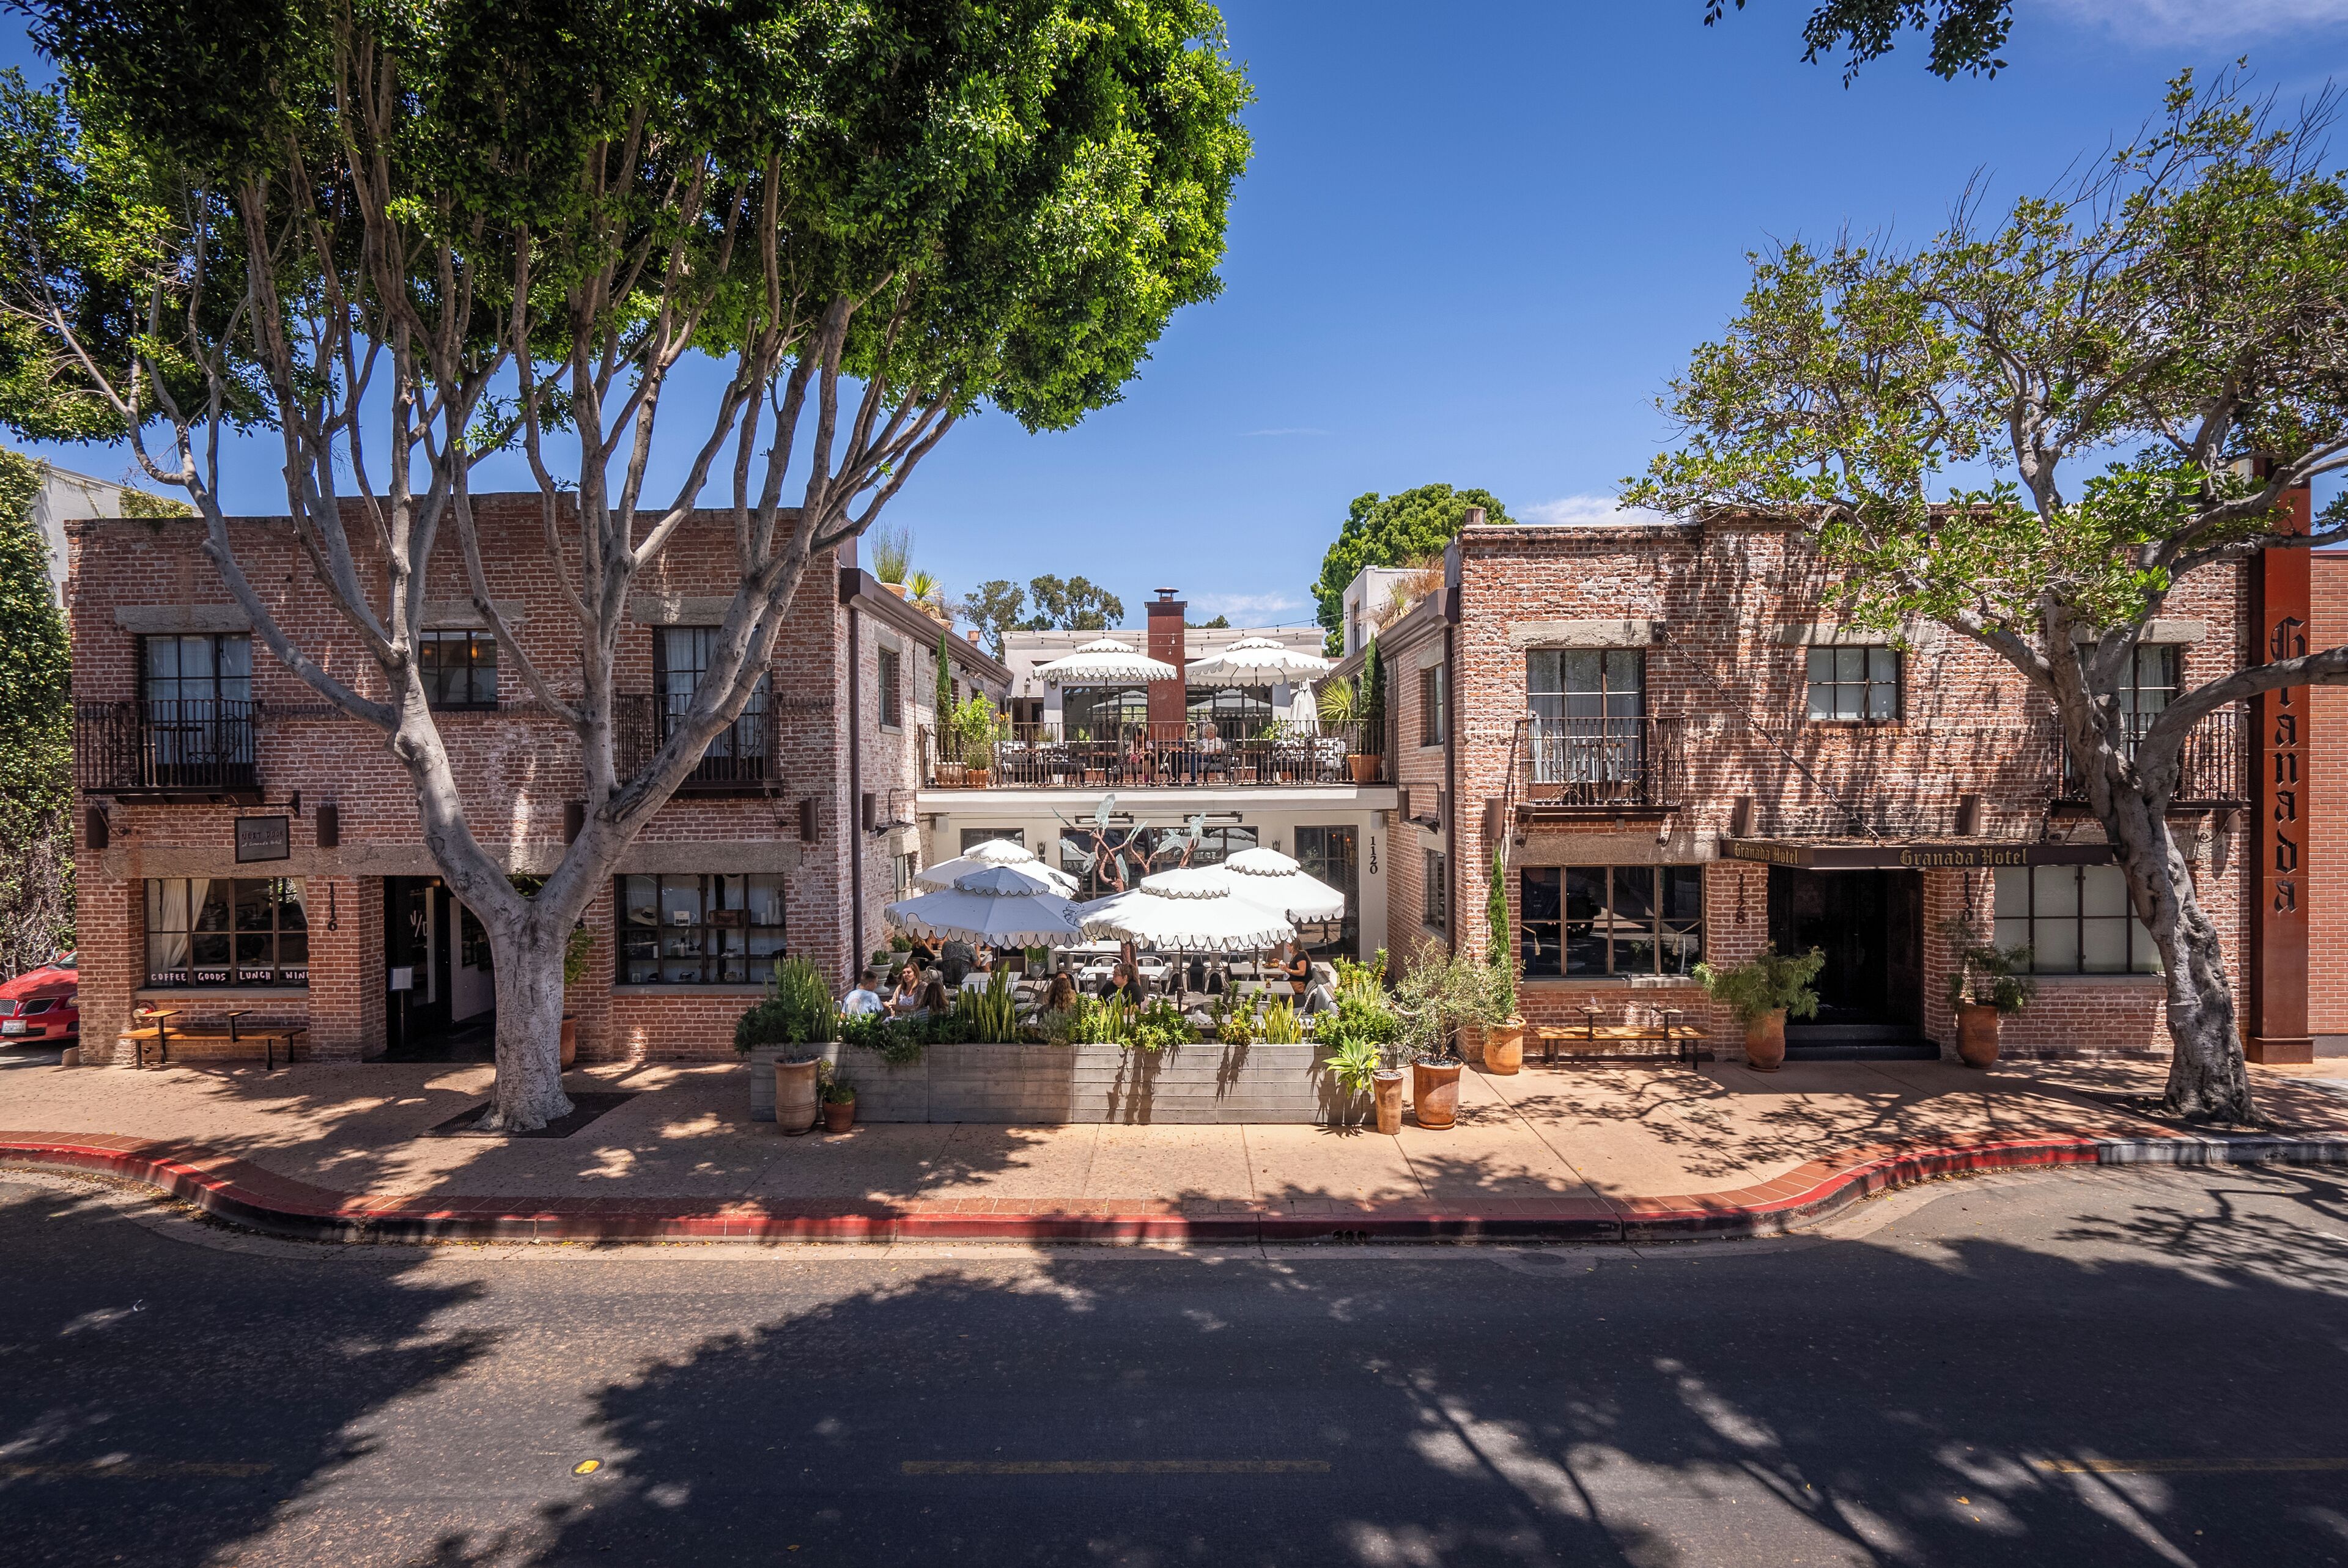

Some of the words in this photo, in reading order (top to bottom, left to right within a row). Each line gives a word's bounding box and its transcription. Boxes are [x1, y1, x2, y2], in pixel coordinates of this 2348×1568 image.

[241, 831, 261, 841] NEXT
[266, 830, 284, 839] DOOR
[1370, 836, 1378, 874] 1120
[1734, 843, 1770, 861] Granada
[1773, 847, 1798, 864] Hotel
[1899, 849, 1974, 866] Granada
[1981, 848, 2028, 865] Hotel
[327, 882, 338, 931] 1116
[1735, 873, 1746, 924] 1128
[1962, 871, 1973, 922] 1130
[151, 973, 186, 981] COFFEE
[198, 973, 226, 981] GOODS
[240, 971, 270, 980] LUNCH
